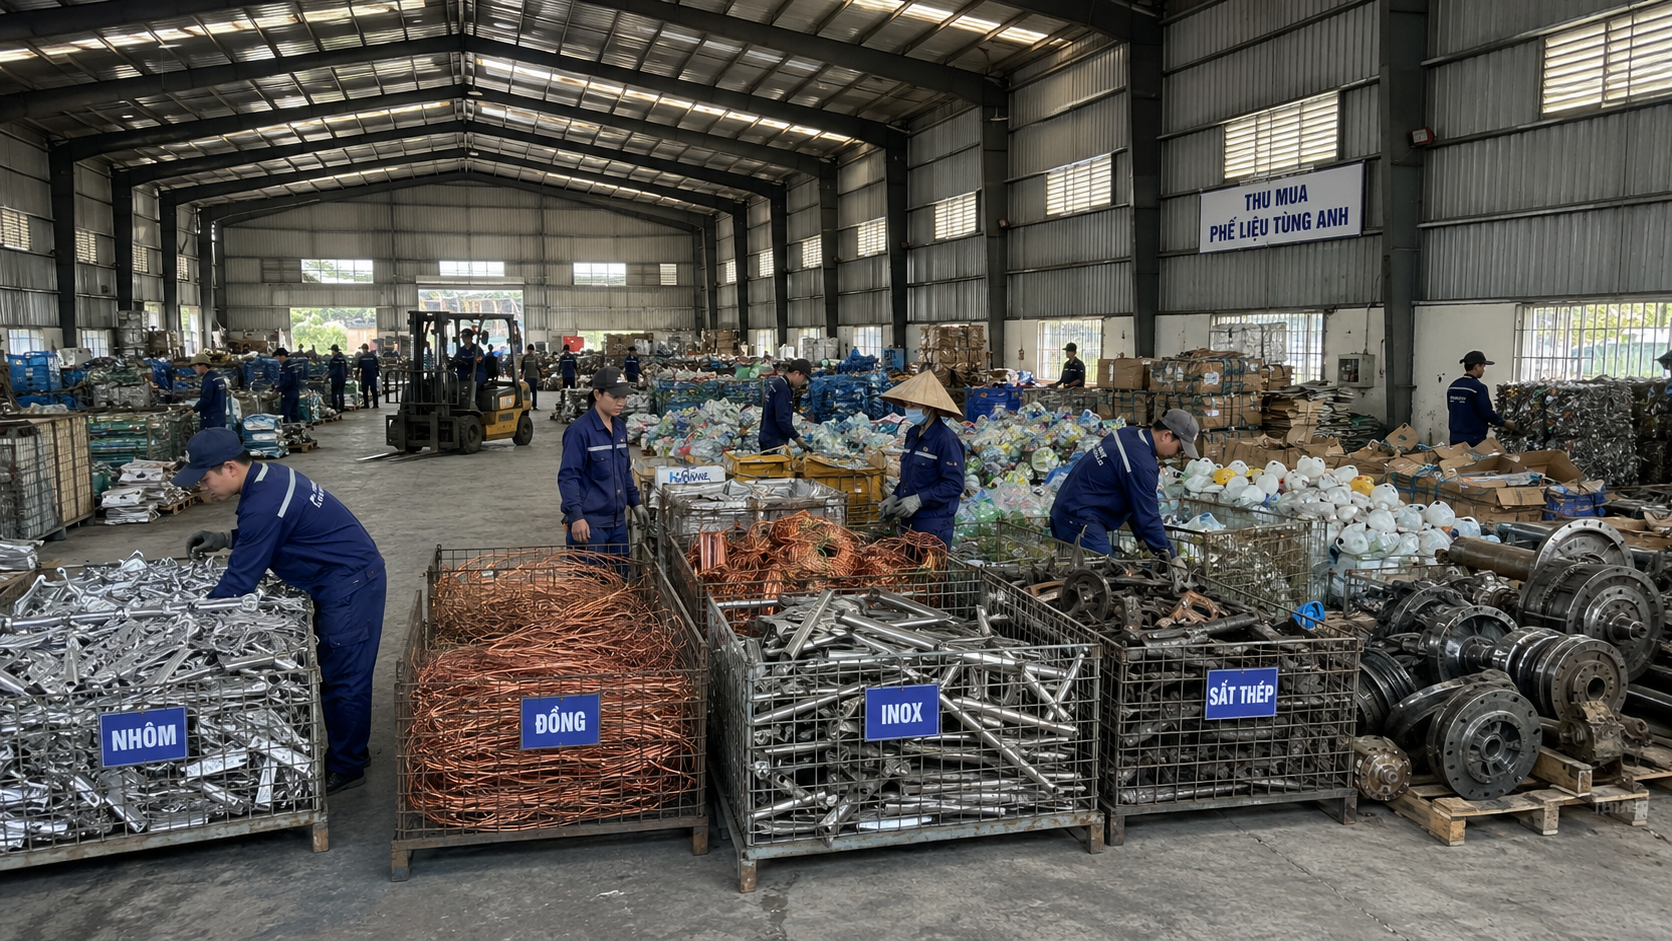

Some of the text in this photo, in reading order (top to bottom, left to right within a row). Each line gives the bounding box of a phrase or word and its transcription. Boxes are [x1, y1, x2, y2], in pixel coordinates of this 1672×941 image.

[1245, 184, 1308, 211] THU MUA
[1210, 206, 1349, 243] PHẾ LIỆU TÙNG ANH
[1239, 680, 1274, 704] THÉP
[535, 705, 586, 735] ĐỒNG
[881, 702, 923, 725] INOX
[111, 721, 177, 752] NHÔM
